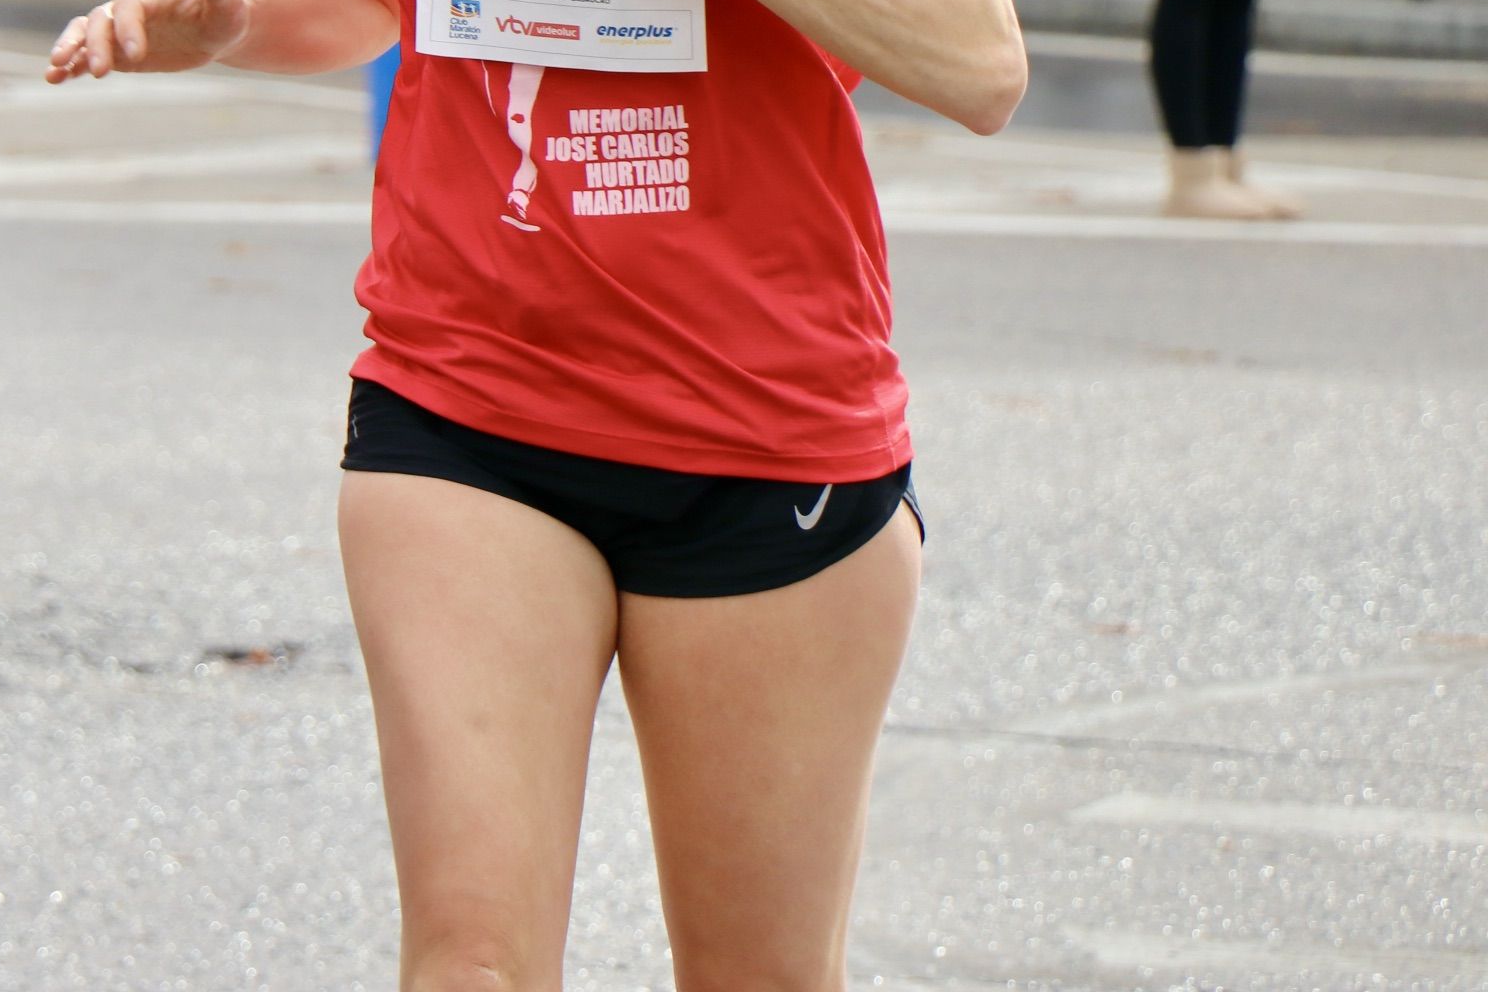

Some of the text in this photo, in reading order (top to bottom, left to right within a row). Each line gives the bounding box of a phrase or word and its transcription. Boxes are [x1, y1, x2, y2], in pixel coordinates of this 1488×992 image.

[449, 25, 480, 34] Maratón
[450, 17, 468, 25] Club
[496, 15, 577, 38] vtv videoluc
[597, 24, 673, 40] enerplus
[449, 32, 478, 40] Lucena
[569, 105, 689, 135] MEMORIAL
[545, 132, 690, 162] JOSE CARLOS
[586, 158, 690, 188] HURTADO
[572, 186, 691, 216] MARJALIZO
